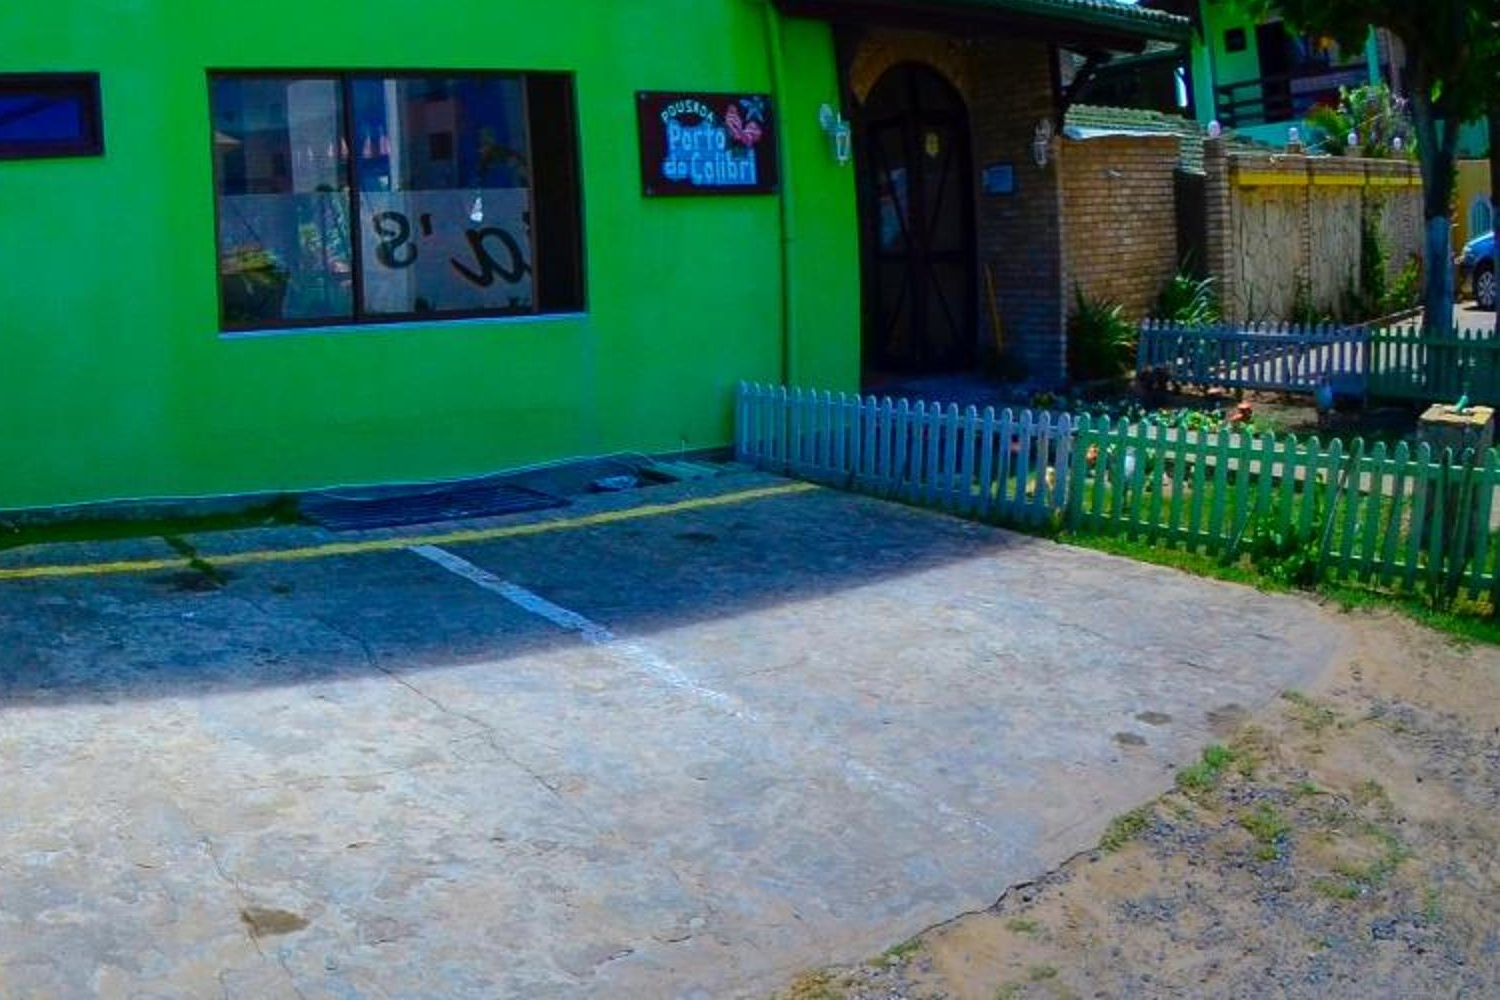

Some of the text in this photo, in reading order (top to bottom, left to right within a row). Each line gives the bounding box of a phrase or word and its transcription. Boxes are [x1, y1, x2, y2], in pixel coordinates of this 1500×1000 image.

[661, 100, 714, 122] POUSADA
[668, 120, 726, 151] Porto
[663, 148, 757, 183] do Colibri
